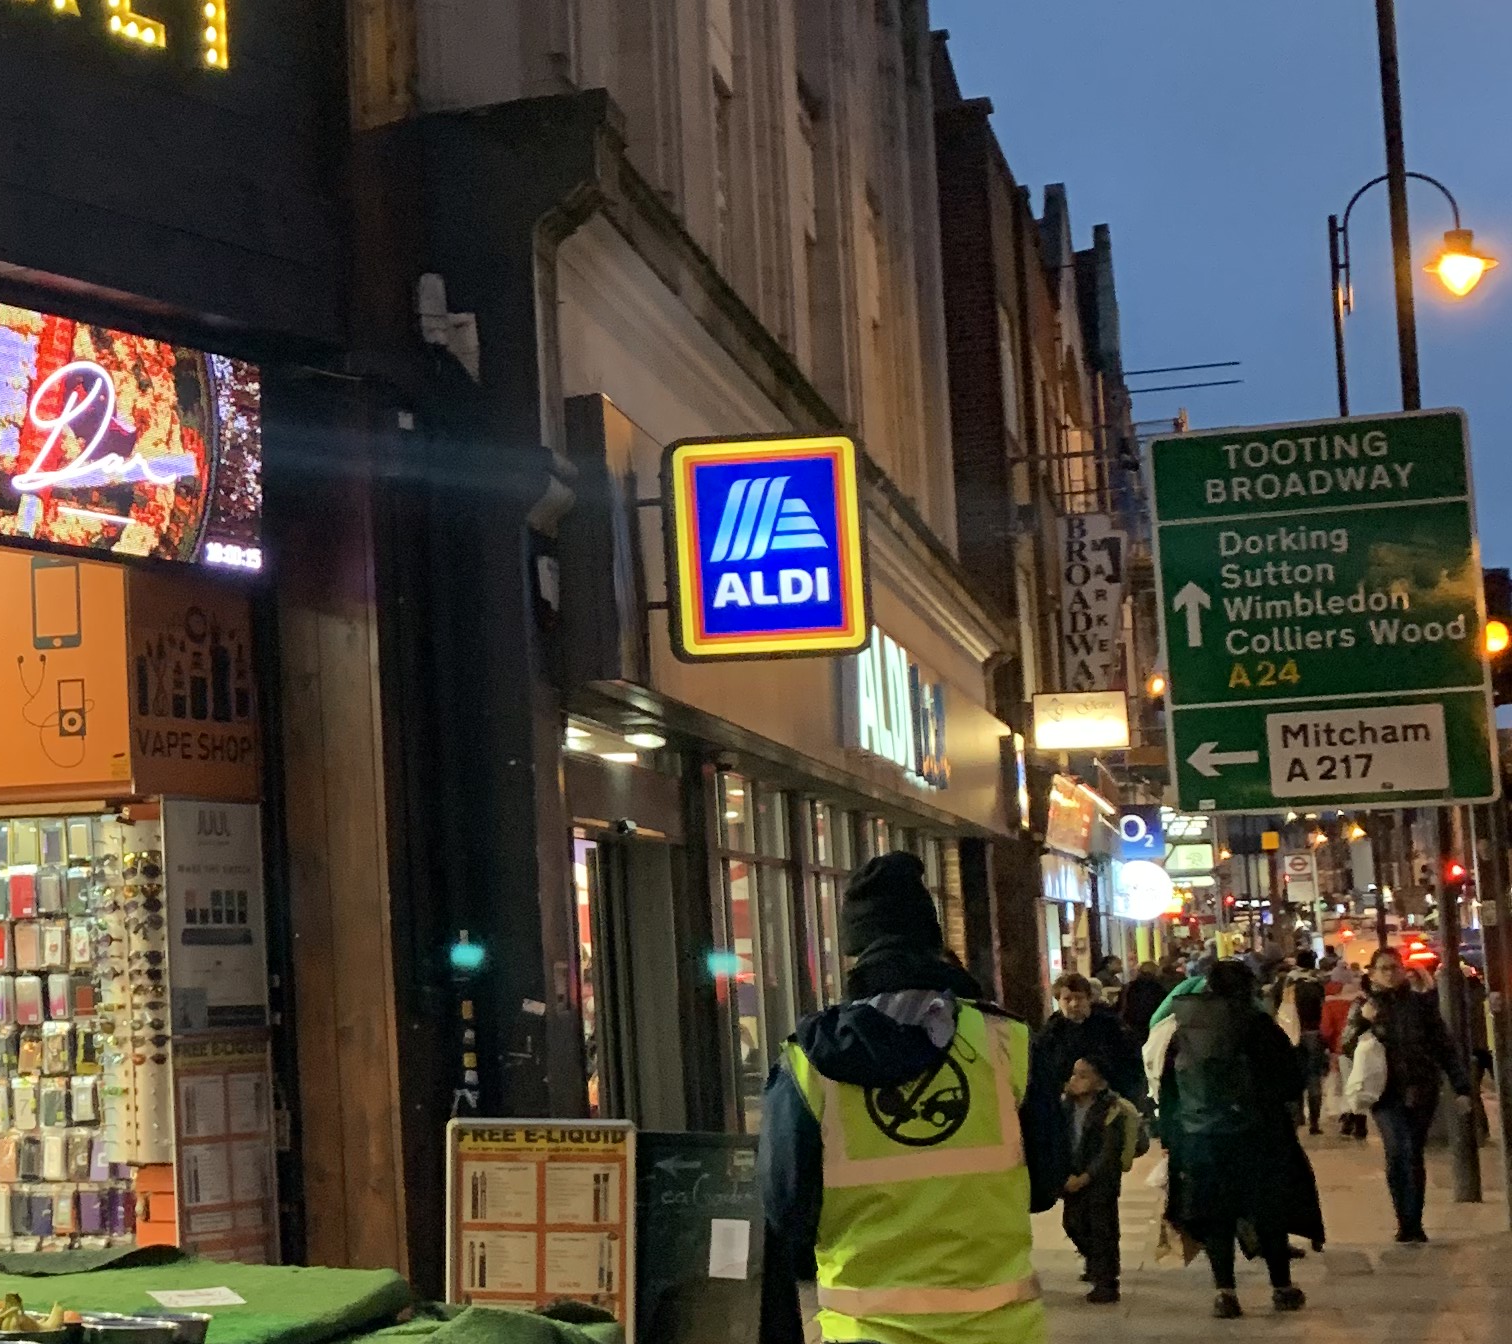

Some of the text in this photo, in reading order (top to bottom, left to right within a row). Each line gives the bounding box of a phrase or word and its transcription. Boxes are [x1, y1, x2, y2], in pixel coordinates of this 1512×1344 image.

[1222, 430, 1389, 469] TOOTING
[1205, 462, 1414, 504] BROADWAY
[1219, 525, 1349, 557] Dorking
[713, 568, 830, 608] ALDI
[1220, 559, 1335, 589] Sutton
[1223, 582, 1410, 622] Wimbledon
[1225, 614, 1467, 656] Colliers Wood
[858, 624, 916, 772] ALDI
[138, 729, 253, 764] VAPE SHOP
[1281, 720, 1431, 749] Mitcham
